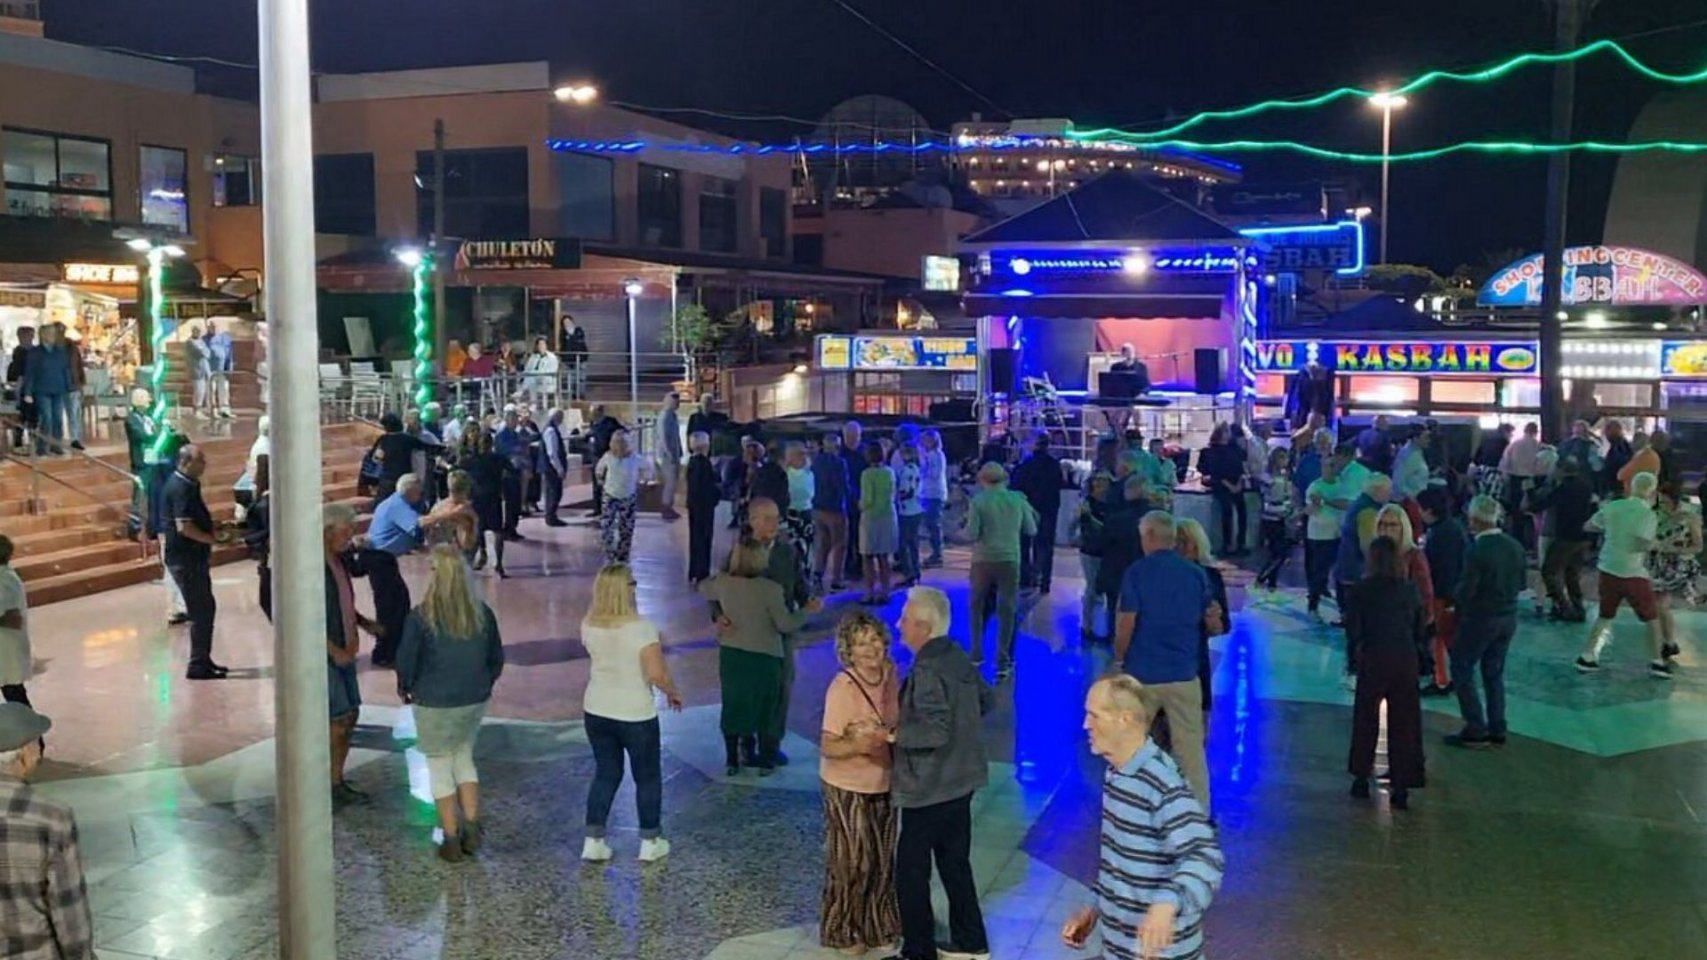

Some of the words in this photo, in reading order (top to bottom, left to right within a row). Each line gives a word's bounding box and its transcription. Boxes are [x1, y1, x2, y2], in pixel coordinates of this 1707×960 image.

[466, 239, 555, 257] CHULETÓN
[1493, 246, 1611, 295] SHOING
[1336, 344, 1492, 371] KASBAH
